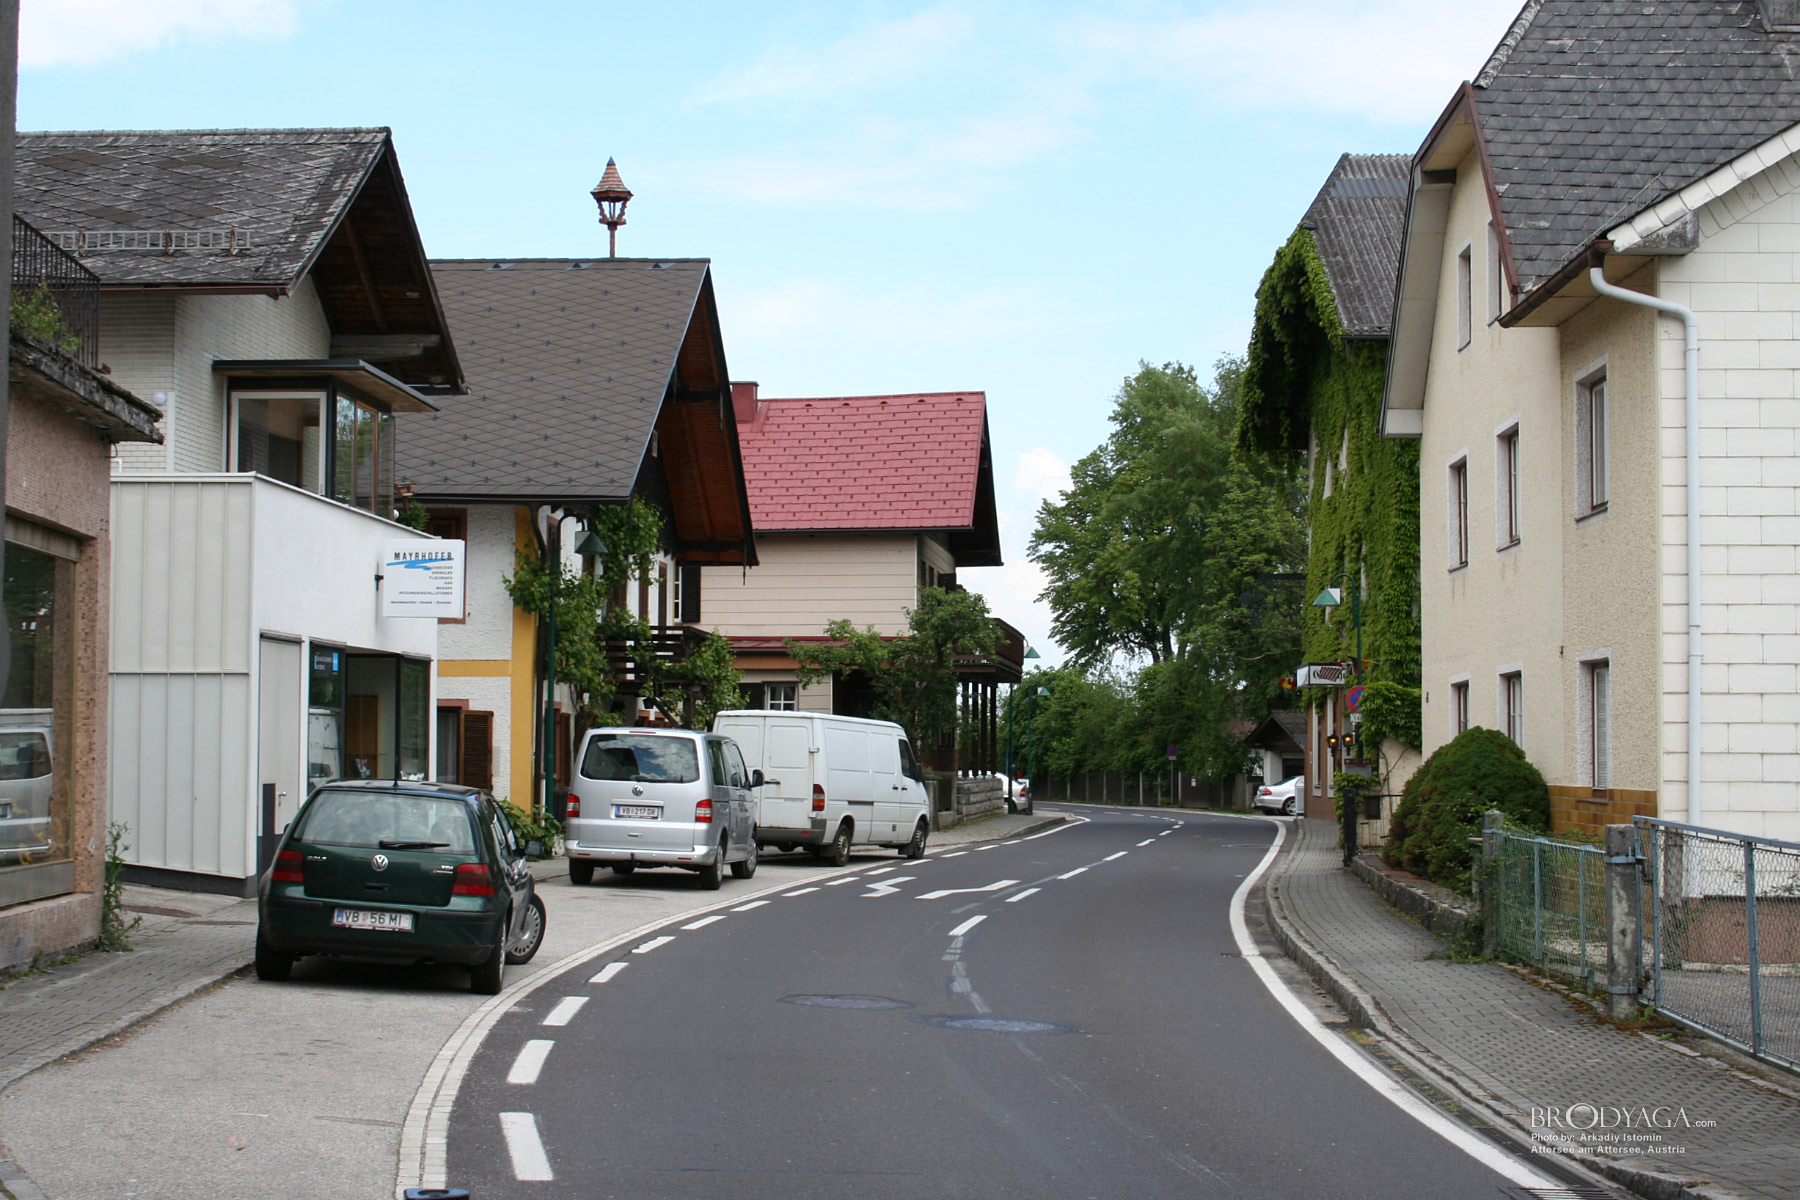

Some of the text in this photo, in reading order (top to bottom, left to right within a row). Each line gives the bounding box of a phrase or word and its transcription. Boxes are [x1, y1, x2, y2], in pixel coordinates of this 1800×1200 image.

[394, 552, 453, 561] MAYRHOFER
[345, 911, 360, 923] VB
[370, 912, 386, 925] 56
[389, 914, 402, 926] MI
